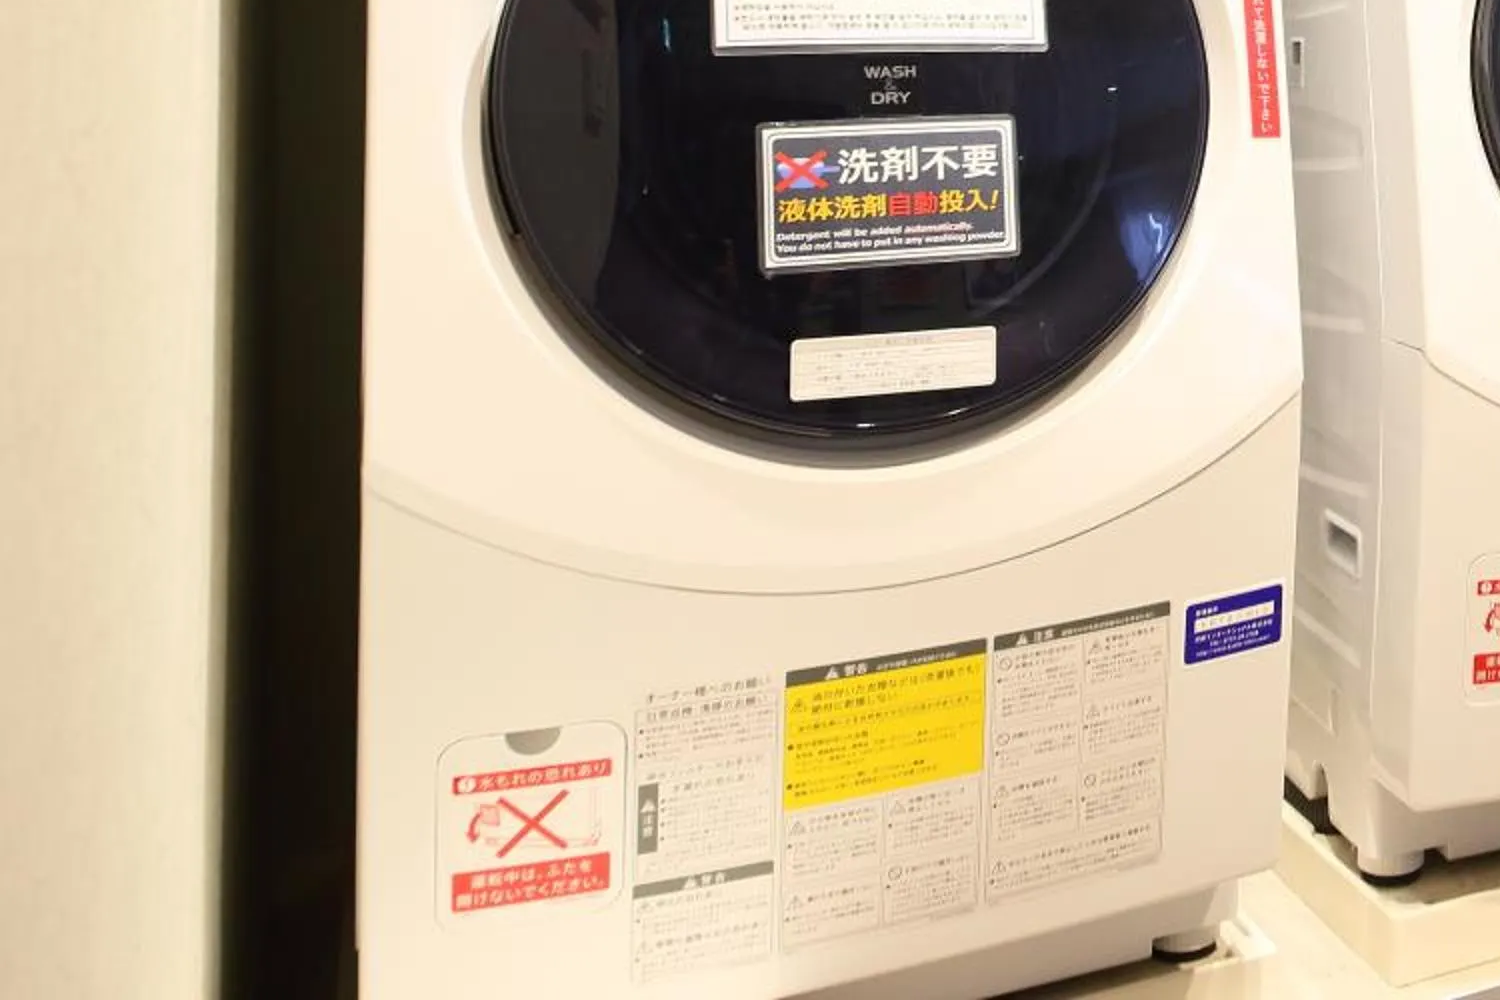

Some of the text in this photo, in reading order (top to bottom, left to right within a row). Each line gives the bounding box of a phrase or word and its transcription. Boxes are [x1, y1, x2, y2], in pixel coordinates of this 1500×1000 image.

[864, 65, 917, 79] WASH
[871, 91, 912, 105] DRY
[837, 144, 999, 184] 洗剤不要
[776, 230, 830, 243] Detergent
[870, 224, 902, 236] added
[777, 243, 797, 254] You
[814, 241, 833, 251] not
[862, 238, 873, 248] to
[874, 237, 892, 249] put
[905, 235, 922, 246] any
